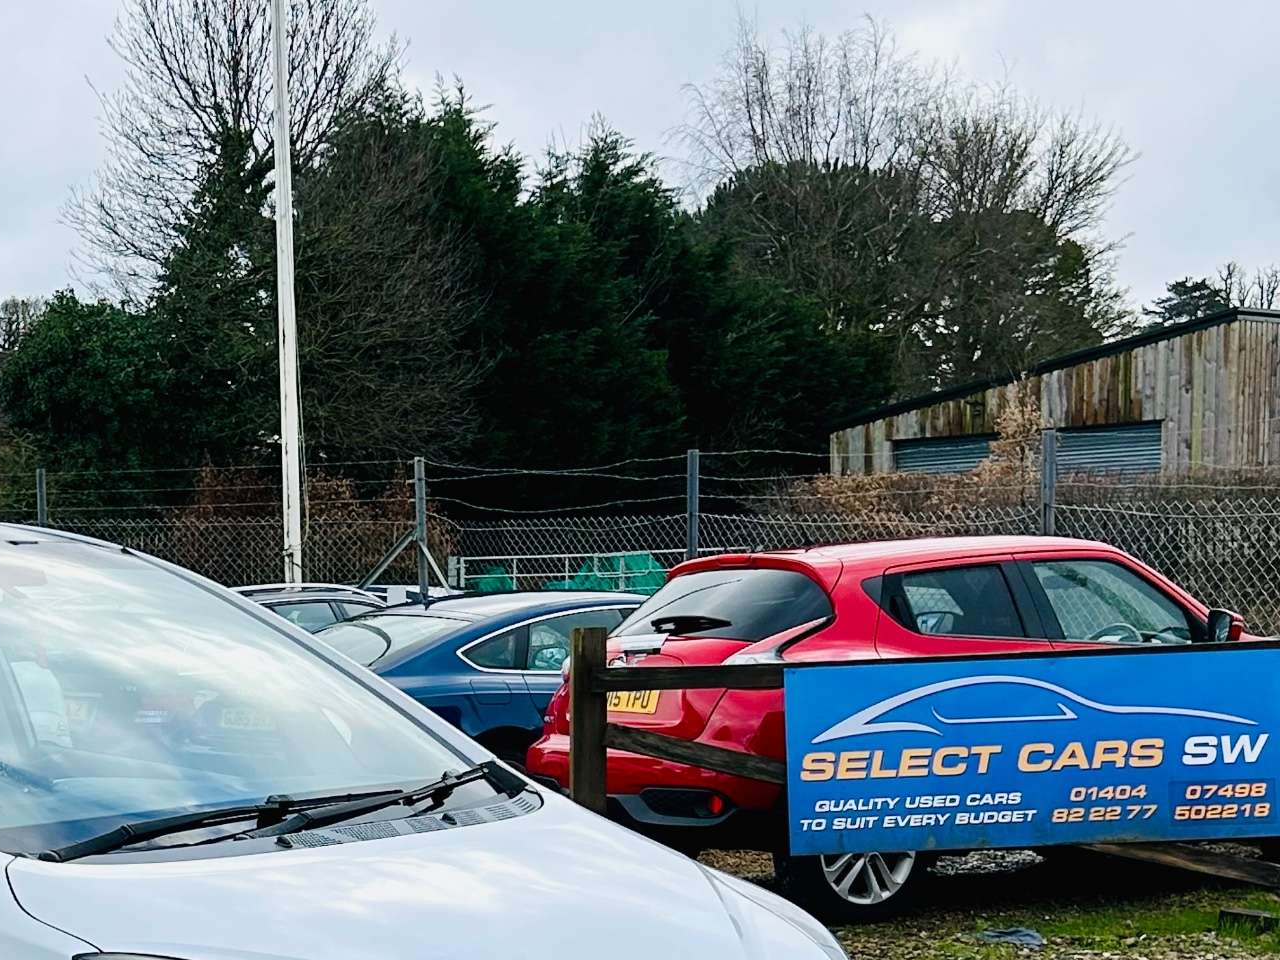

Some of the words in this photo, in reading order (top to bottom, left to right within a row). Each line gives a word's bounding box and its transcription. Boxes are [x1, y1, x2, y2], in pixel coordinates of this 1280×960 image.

[800, 745, 1002, 781] SELECT
[1017, 738, 1164, 772] CARS
[1182, 733, 1269, 766] SW
[1070, 785, 1148, 802] 01404
[1185, 783, 1268, 800] 07498
[815, 797, 900, 812] QUALITY
[905, 793, 960, 809] USED
[966, 791, 1022, 806] CARS
[1173, 802, 1271, 820] 502218
[800, 818, 827, 831] TO
[832, 816, 879, 830] SUIT
[883, 813, 950, 828] EVERY
[955, 810, 1037, 826] BUDGET
